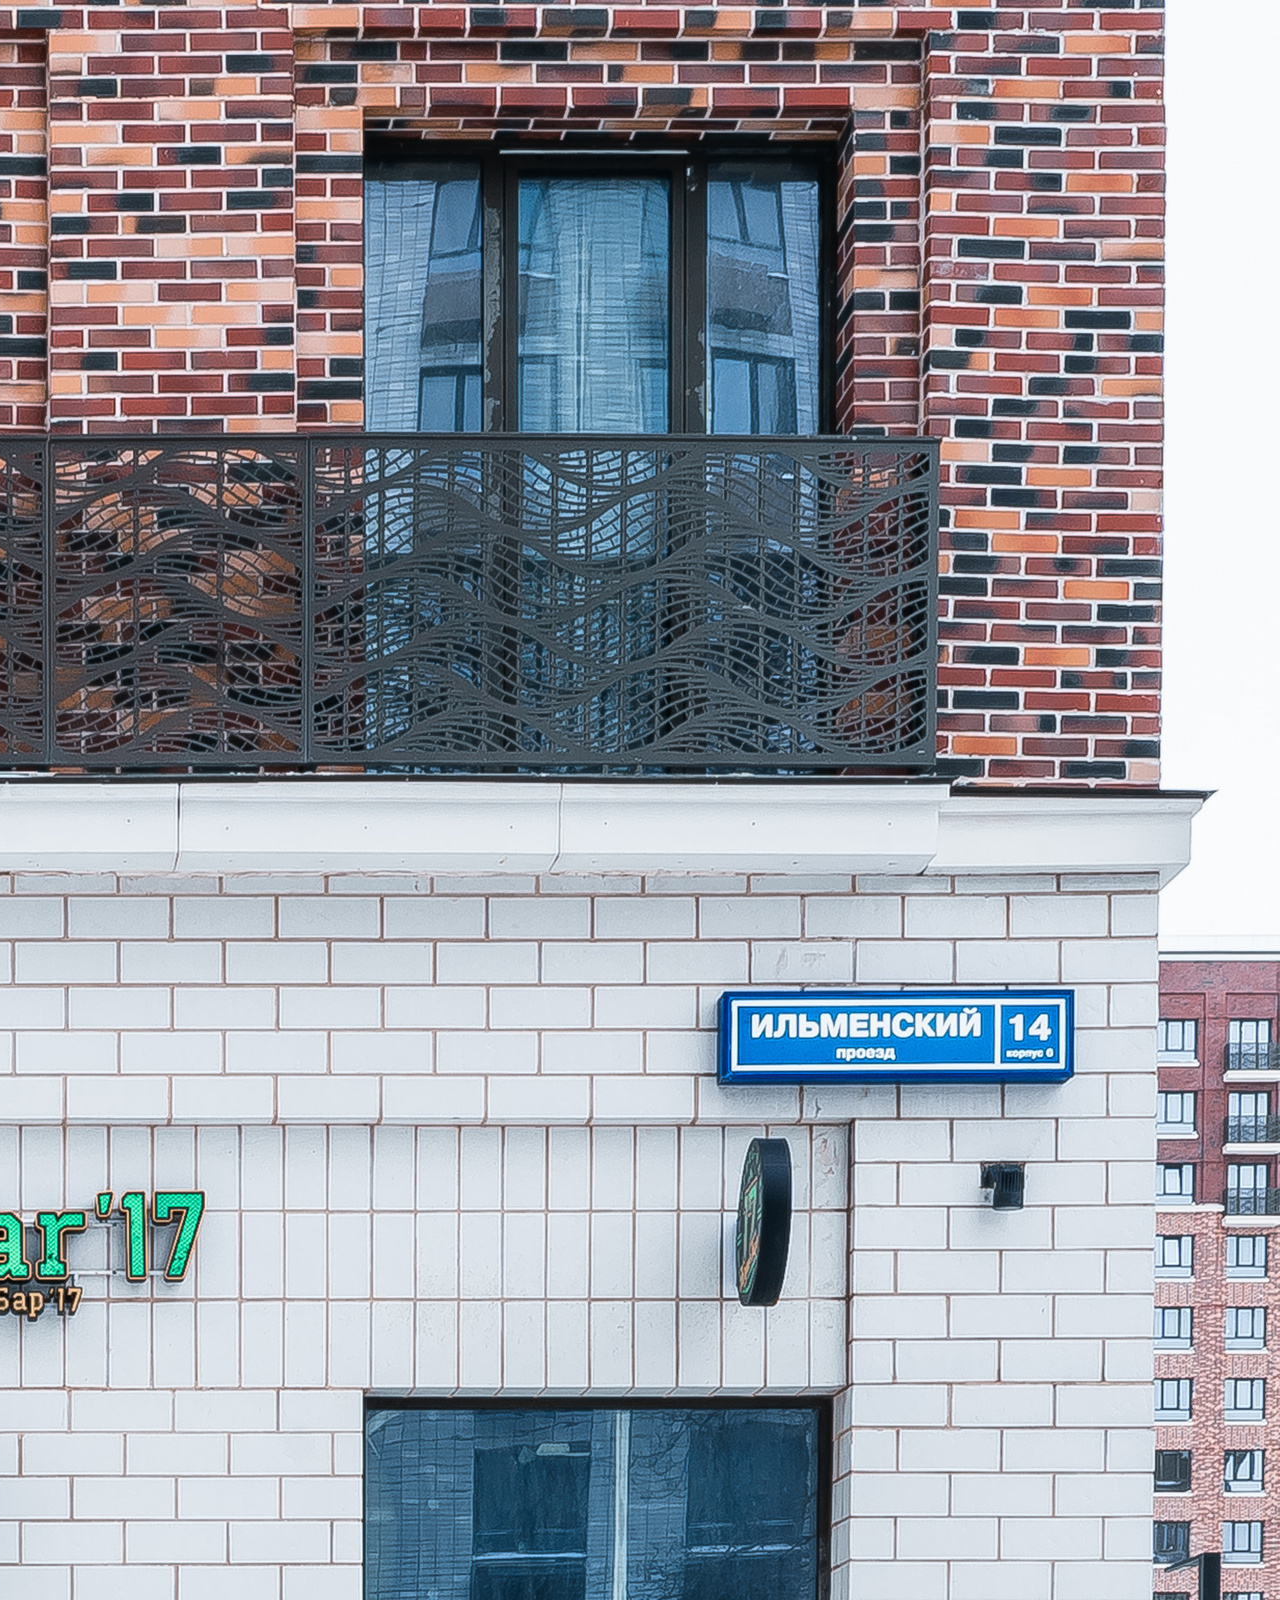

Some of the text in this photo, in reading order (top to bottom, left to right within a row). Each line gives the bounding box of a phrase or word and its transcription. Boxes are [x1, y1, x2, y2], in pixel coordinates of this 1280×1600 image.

[750, 1007, 982, 1038] ИЛЬМЕНСКИЙ
[1008, 1013, 1052, 1041] 14
[835, 1046, 896, 1061] проезд
